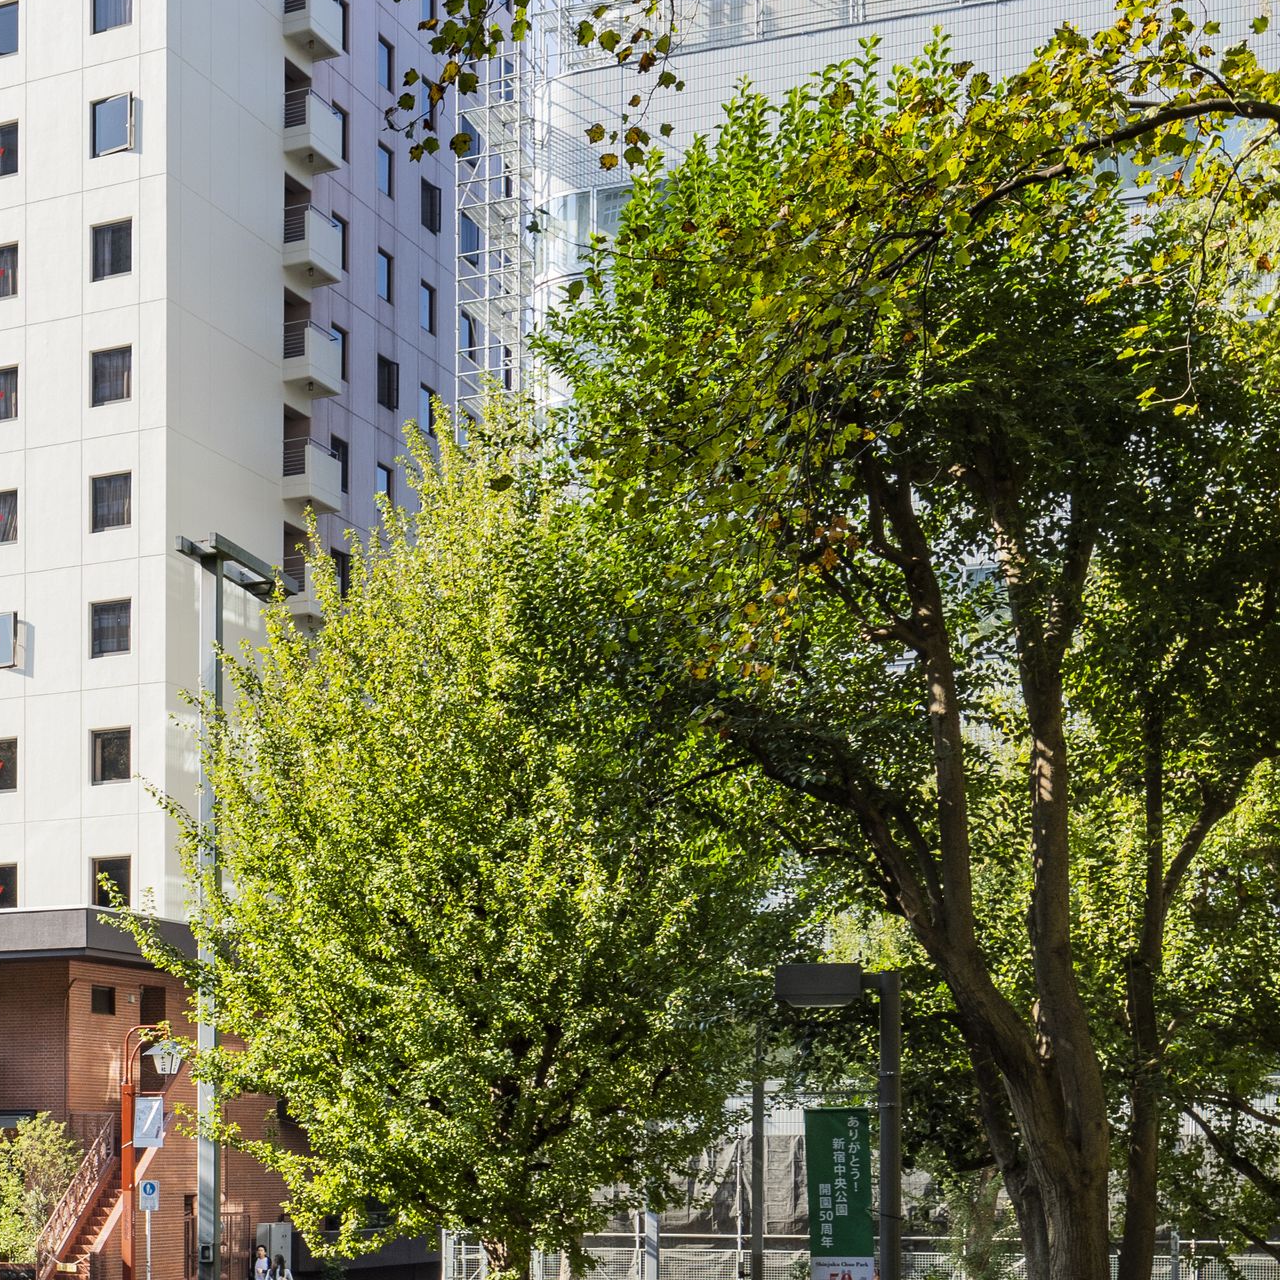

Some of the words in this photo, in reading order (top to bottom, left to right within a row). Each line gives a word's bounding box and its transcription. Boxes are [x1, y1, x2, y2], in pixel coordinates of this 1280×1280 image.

[832, 1138, 848, 1216] 新宿中央公園
[847, 1116, 860, 1192] ありがとう！
[819, 1183, 834, 1248] 開園50周年
